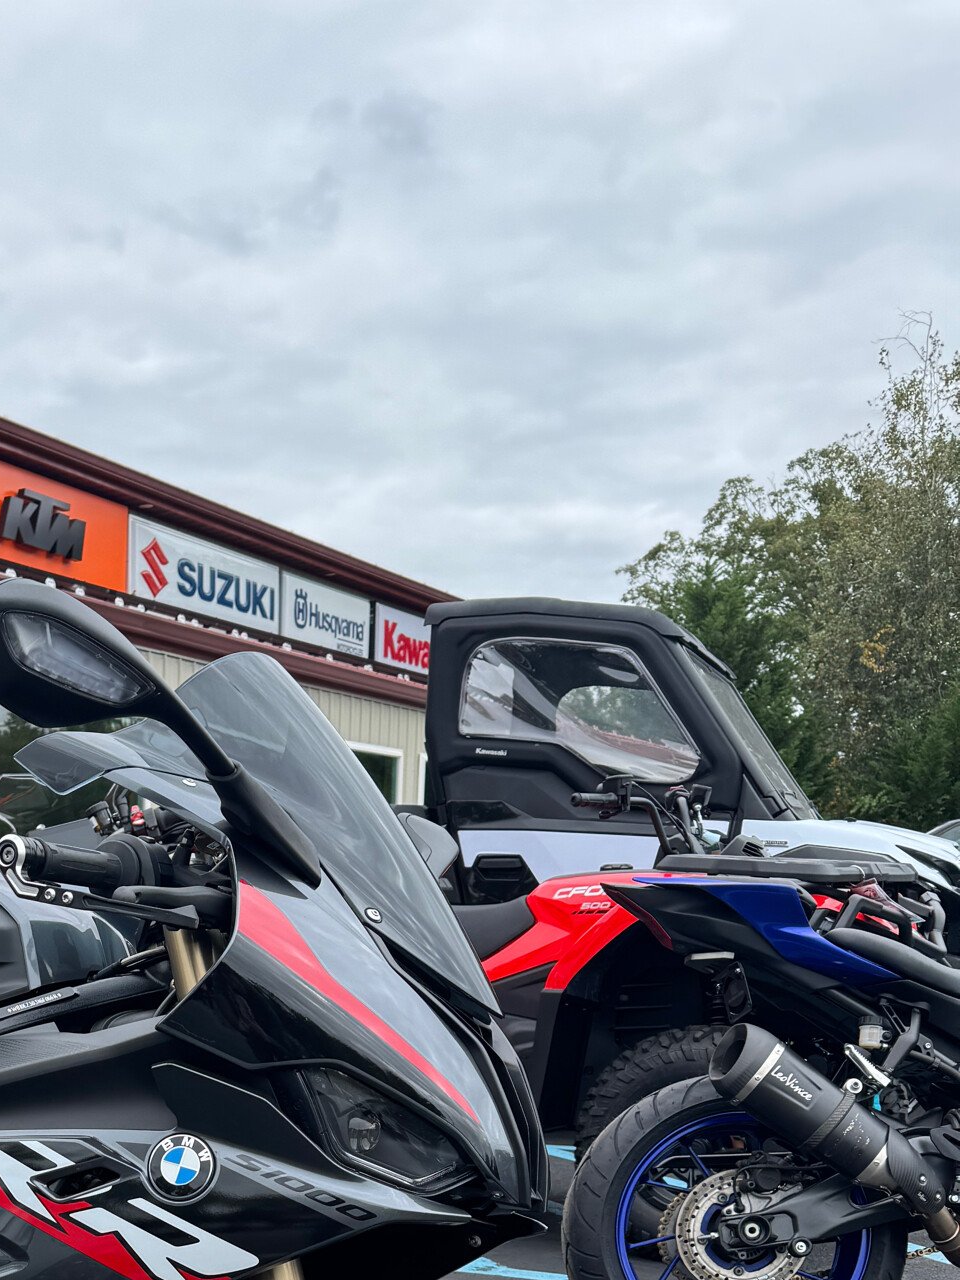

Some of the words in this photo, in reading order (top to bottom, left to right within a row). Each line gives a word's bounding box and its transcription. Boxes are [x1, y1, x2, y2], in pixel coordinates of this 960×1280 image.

[177, 557, 275, 621] SUZUKI
[309, 602, 364, 641] Husqvarna
[552, 885, 606, 899] CFO
[580, 902, 611, 910] 500
[771, 1065, 814, 1101] LeoVince
[161, 1136, 212, 1163] BMW
[224, 1153, 378, 1222] S1000
